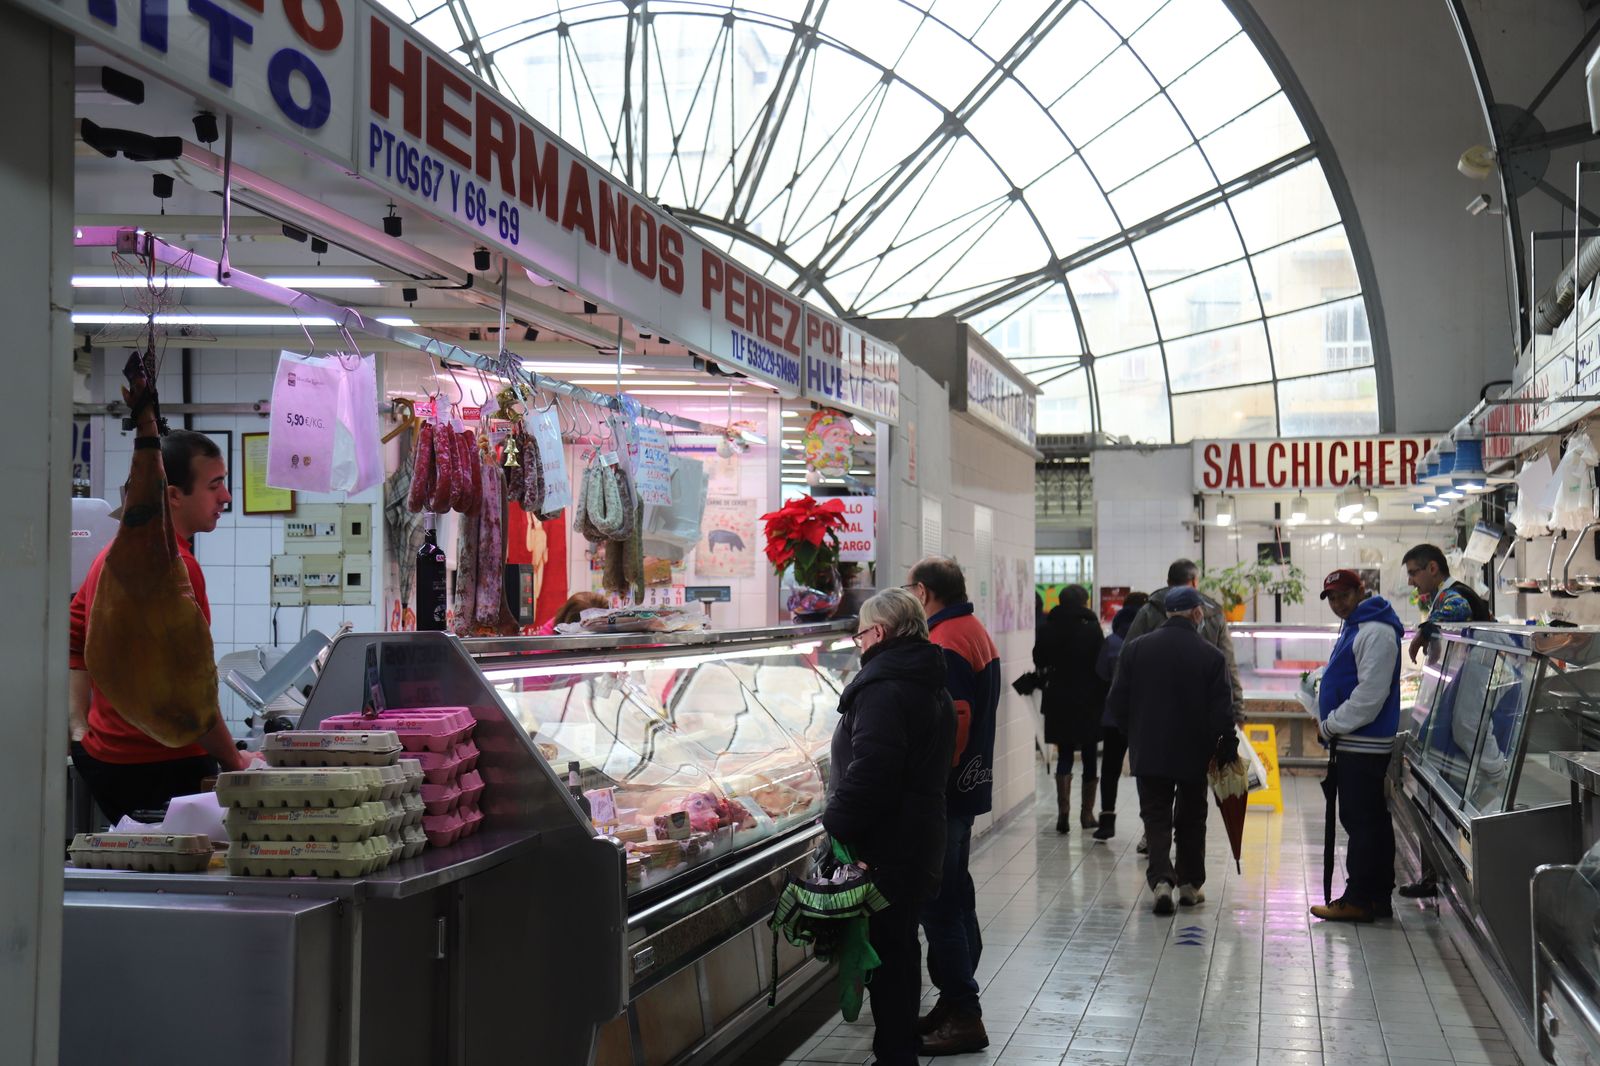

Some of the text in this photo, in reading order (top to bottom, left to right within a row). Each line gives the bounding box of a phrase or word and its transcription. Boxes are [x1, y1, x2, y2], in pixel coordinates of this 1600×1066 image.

[370, 15, 800, 357] HERMANOS PEREZ
[449, 169, 461, 213] Y
[465, 181, 520, 246] 68-69
[731, 329, 746, 361] TLF
